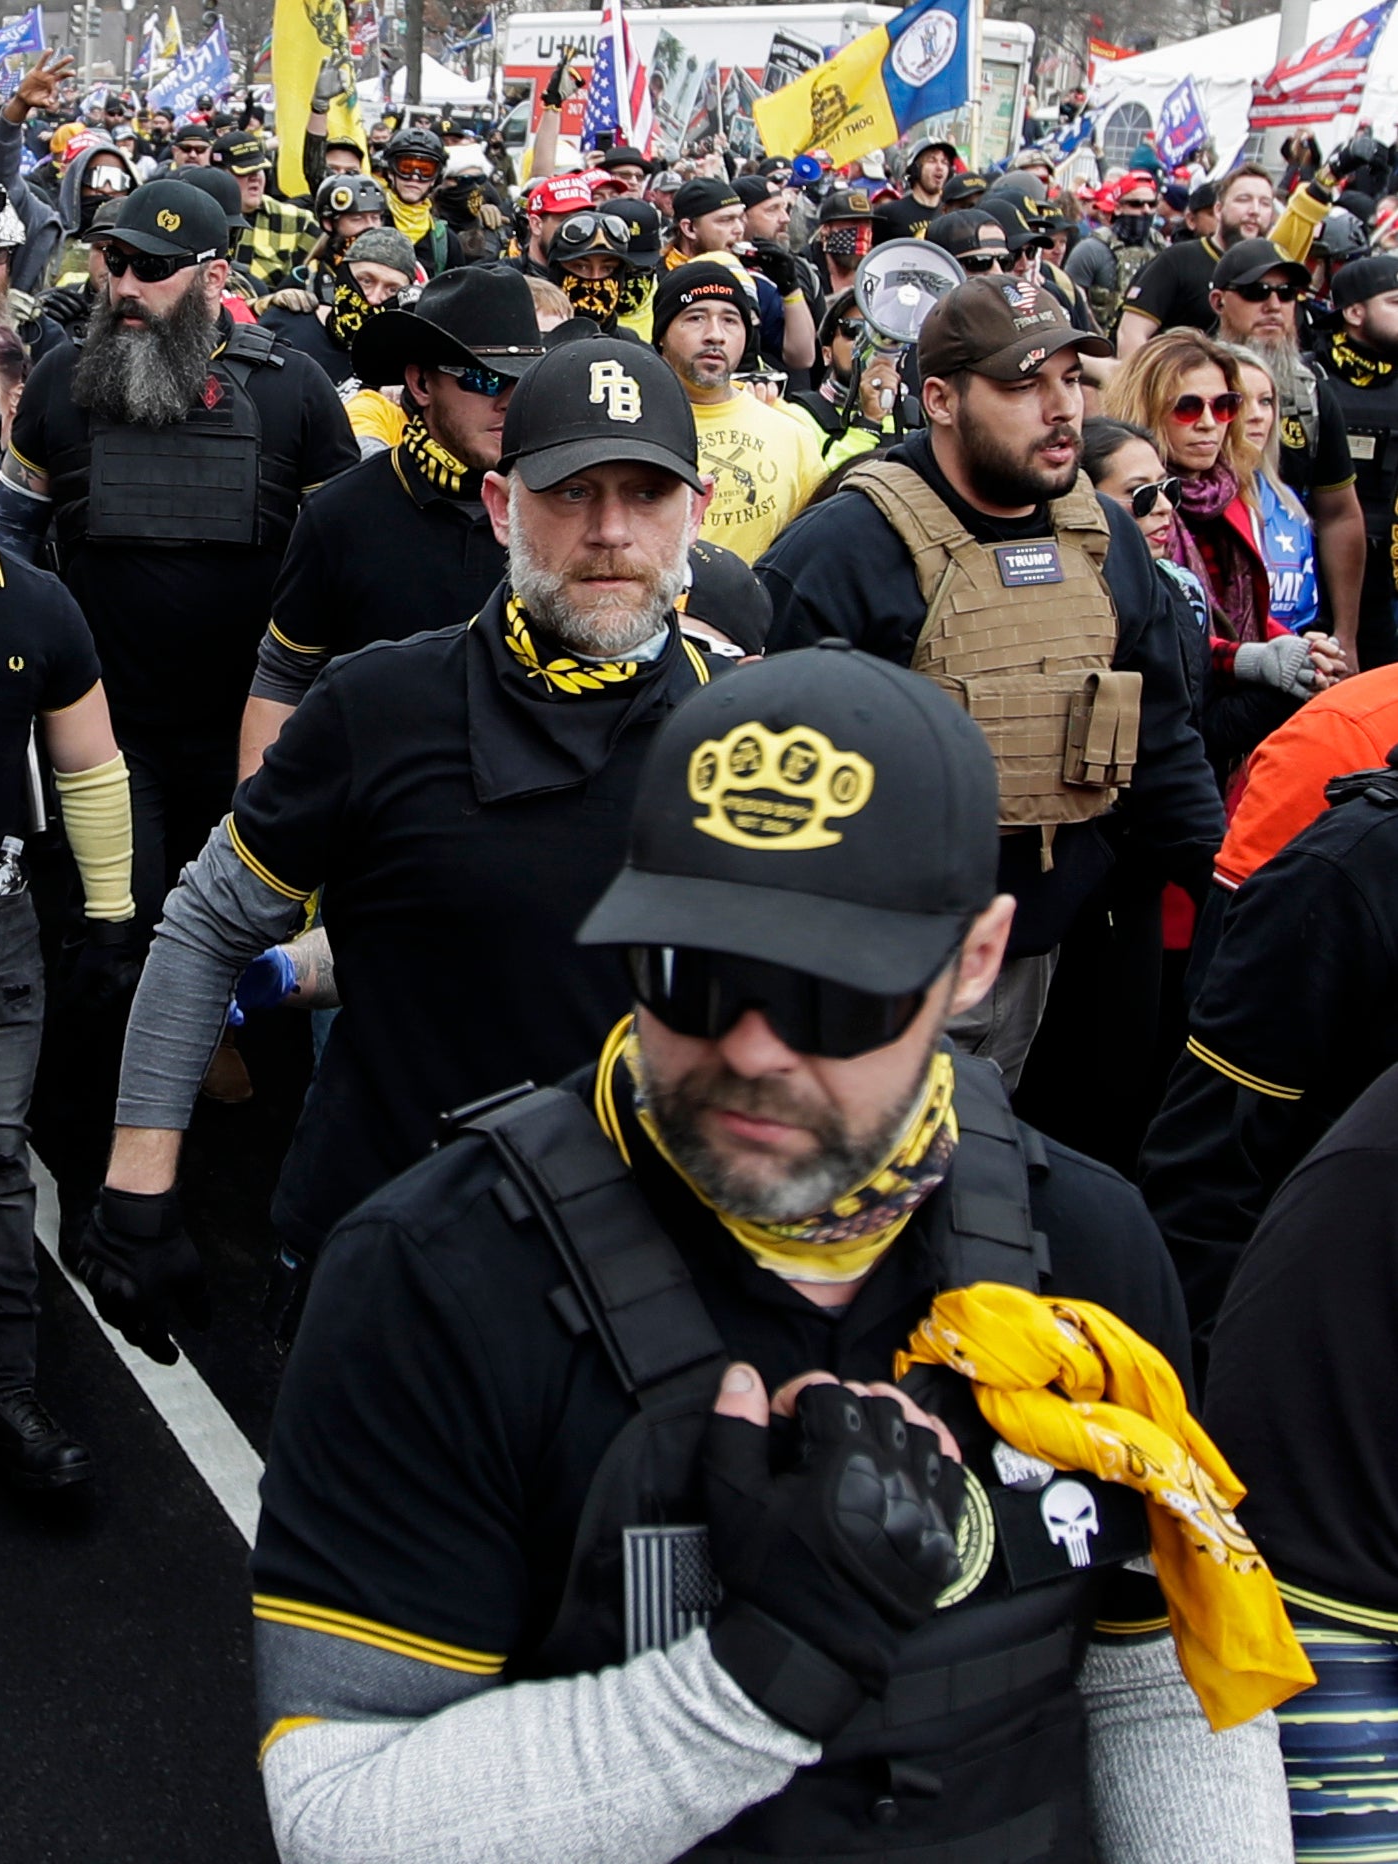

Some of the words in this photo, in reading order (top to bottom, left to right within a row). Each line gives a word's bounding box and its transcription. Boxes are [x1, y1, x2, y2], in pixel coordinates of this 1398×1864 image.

[589, 359, 642, 423] PB
[697, 430, 764, 453] ESTERN
[1005, 553, 1053, 567] TRUMP
